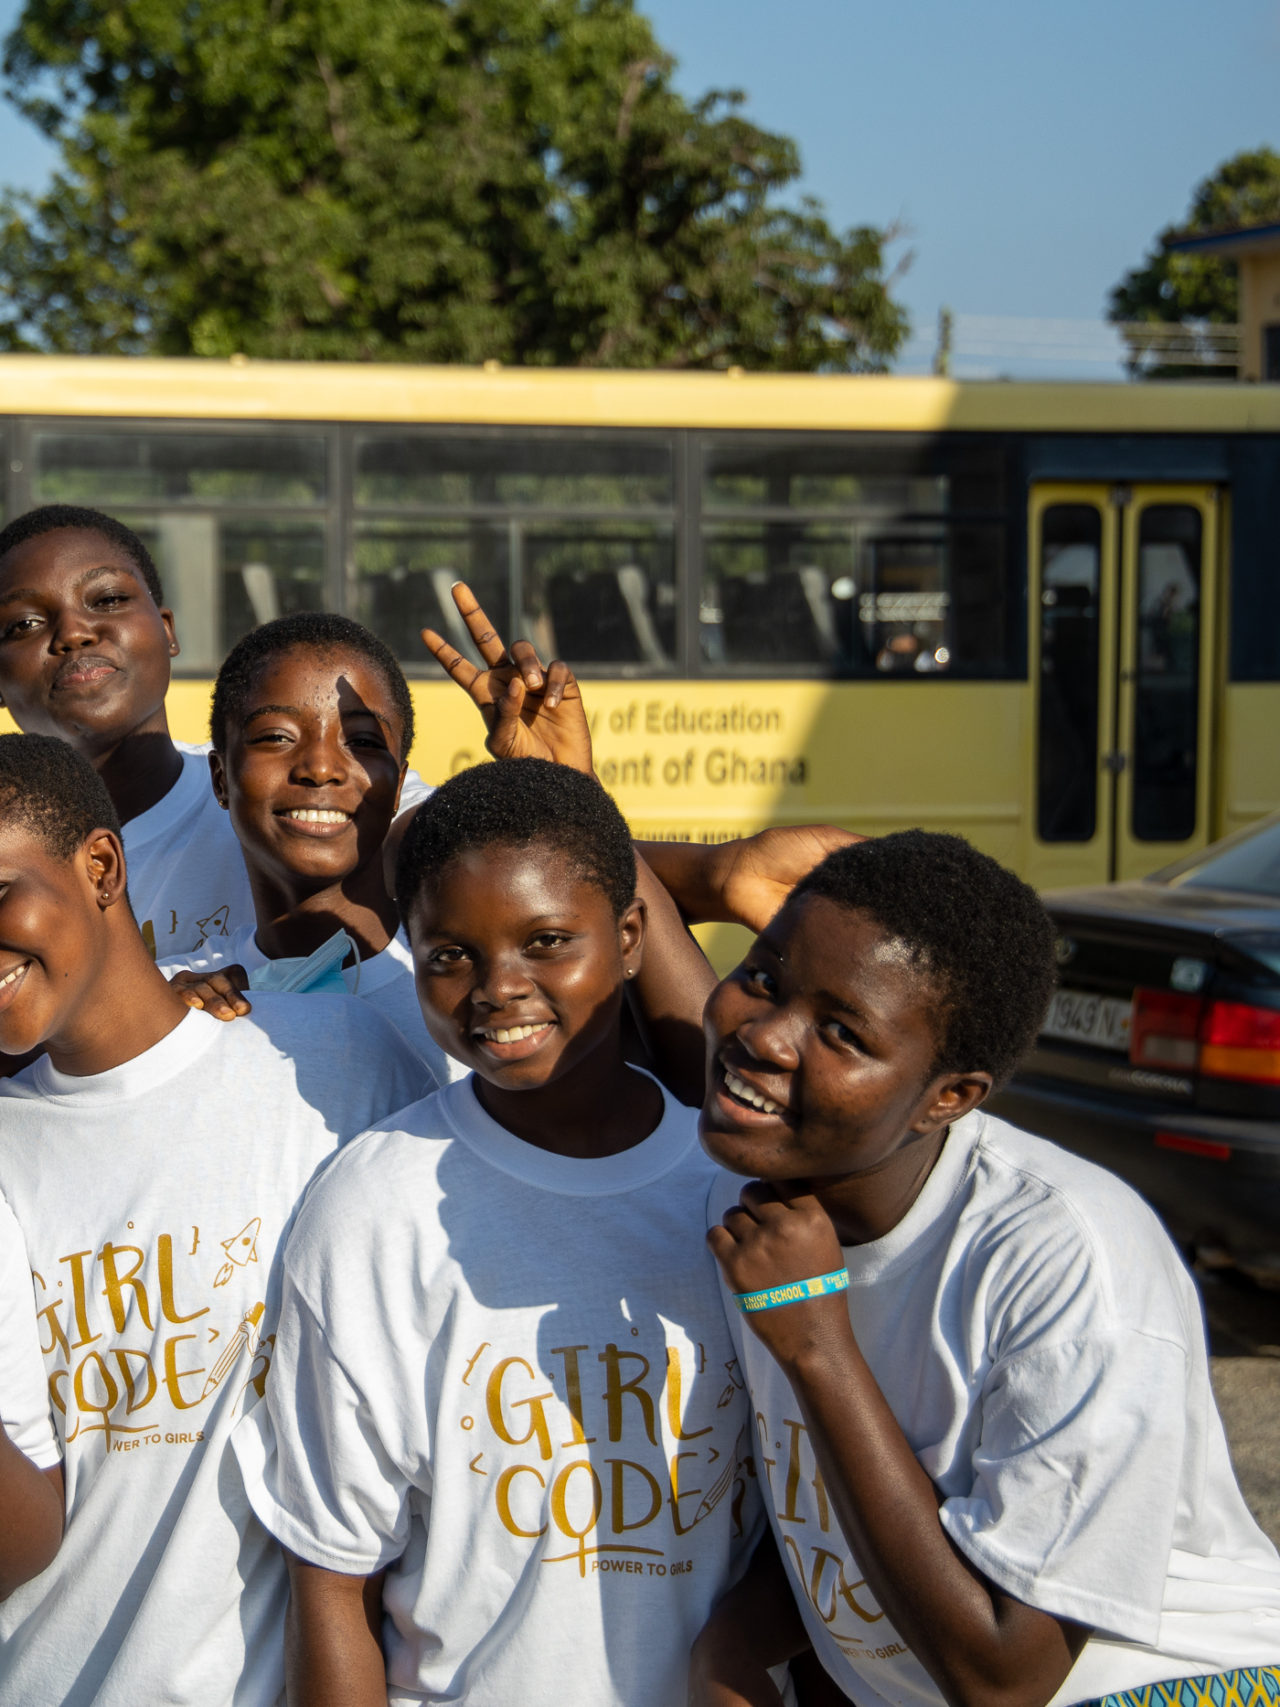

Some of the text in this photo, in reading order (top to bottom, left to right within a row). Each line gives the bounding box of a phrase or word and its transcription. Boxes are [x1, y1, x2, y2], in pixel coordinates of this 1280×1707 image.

[608, 701, 636, 735] of
[644, 702, 782, 735] Education
[662, 750, 694, 785] of
[705, 750, 809, 786] Ghana
[770, 1285, 804, 1304] SCHOOL
[485, 1343, 714, 1461] GIRL
[144, 1434, 161, 1446] TO
[164, 1431, 205, 1445] GIRLS
[495, 1452, 702, 1539] CODE
[591, 1559, 694, 1577] POWER TO GIRLS
